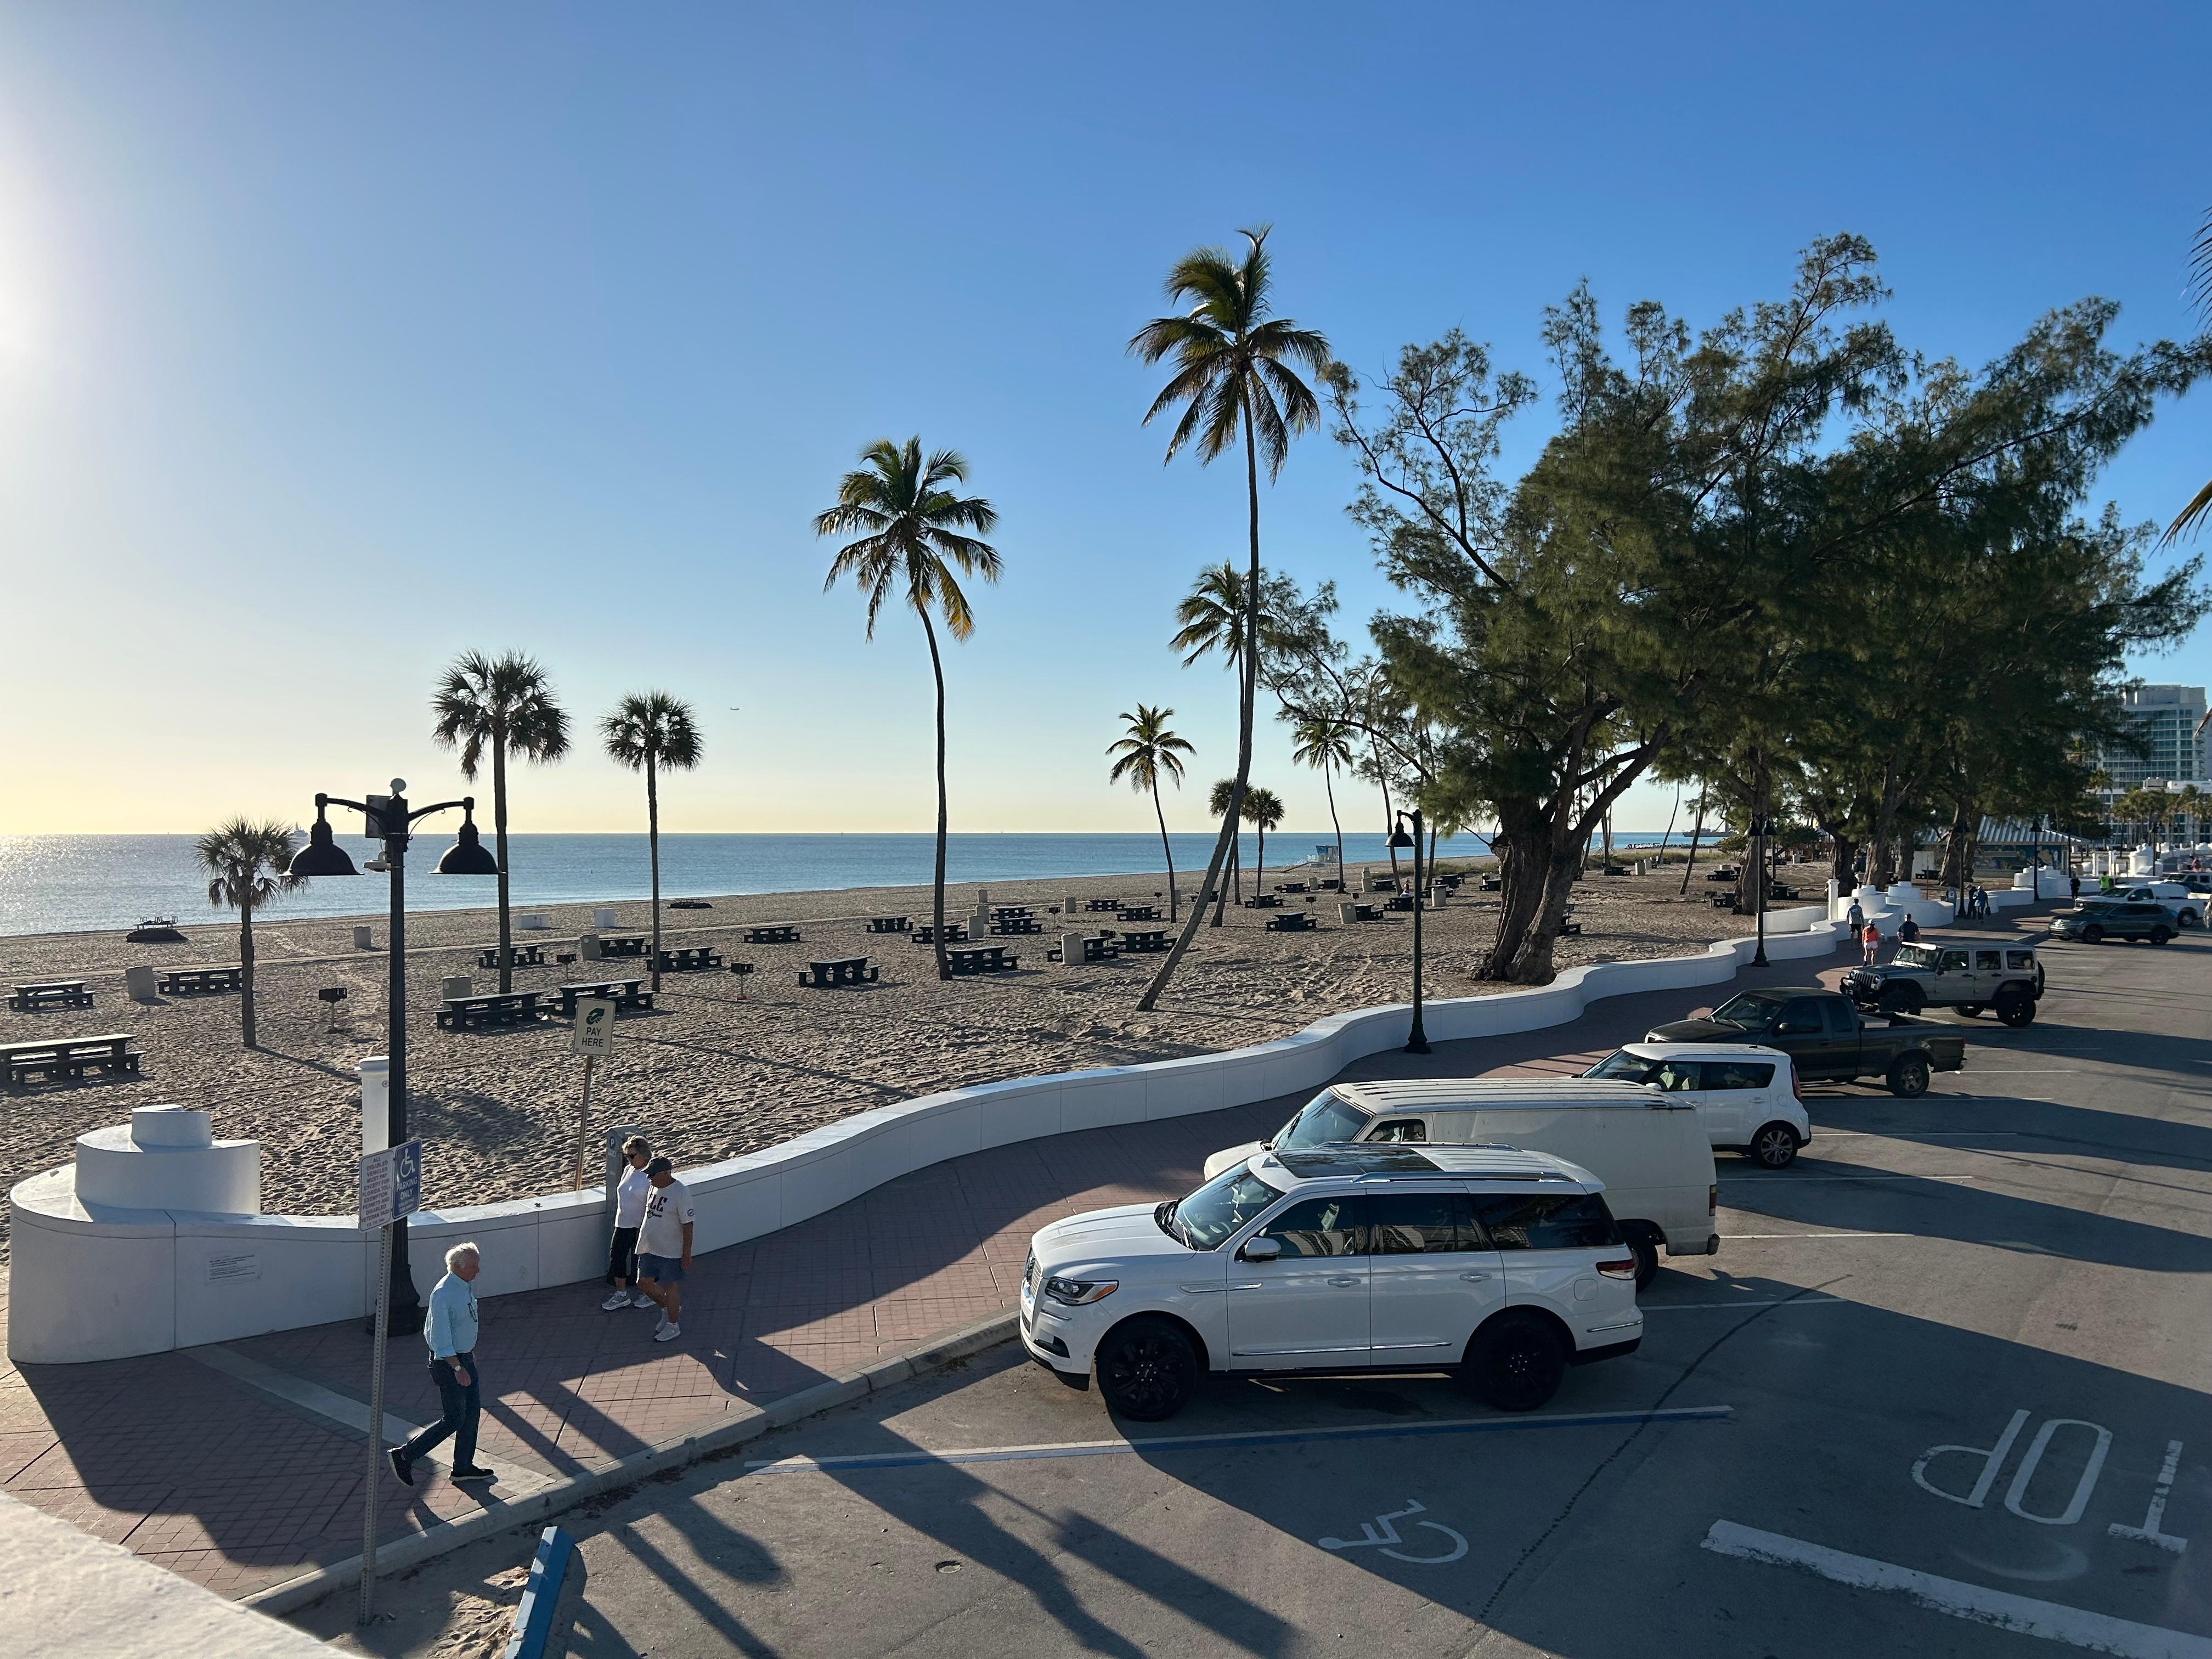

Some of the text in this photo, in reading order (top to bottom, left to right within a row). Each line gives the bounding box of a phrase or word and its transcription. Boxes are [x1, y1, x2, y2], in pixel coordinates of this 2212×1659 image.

[586, 1027, 602, 1036] PAY
[582, 1037, 604, 1047] HERE
[366, 1160, 388, 1171] DISABLED
[366, 1167, 387, 1177] VEHICLES
[364, 1181, 381, 1190] EXCEPT
[396, 1176, 418, 1192] PARKING
[362, 1188, 381, 1197] FLORIDA
[364, 1191, 388, 1203] EXEMPTION
[400, 1188, 413, 1200] ONLY
[363, 1200, 381, 1210] PERMITS
[366, 1204, 386, 1216] DISABLED
[361, 1212, 380, 1223] VETERAN
